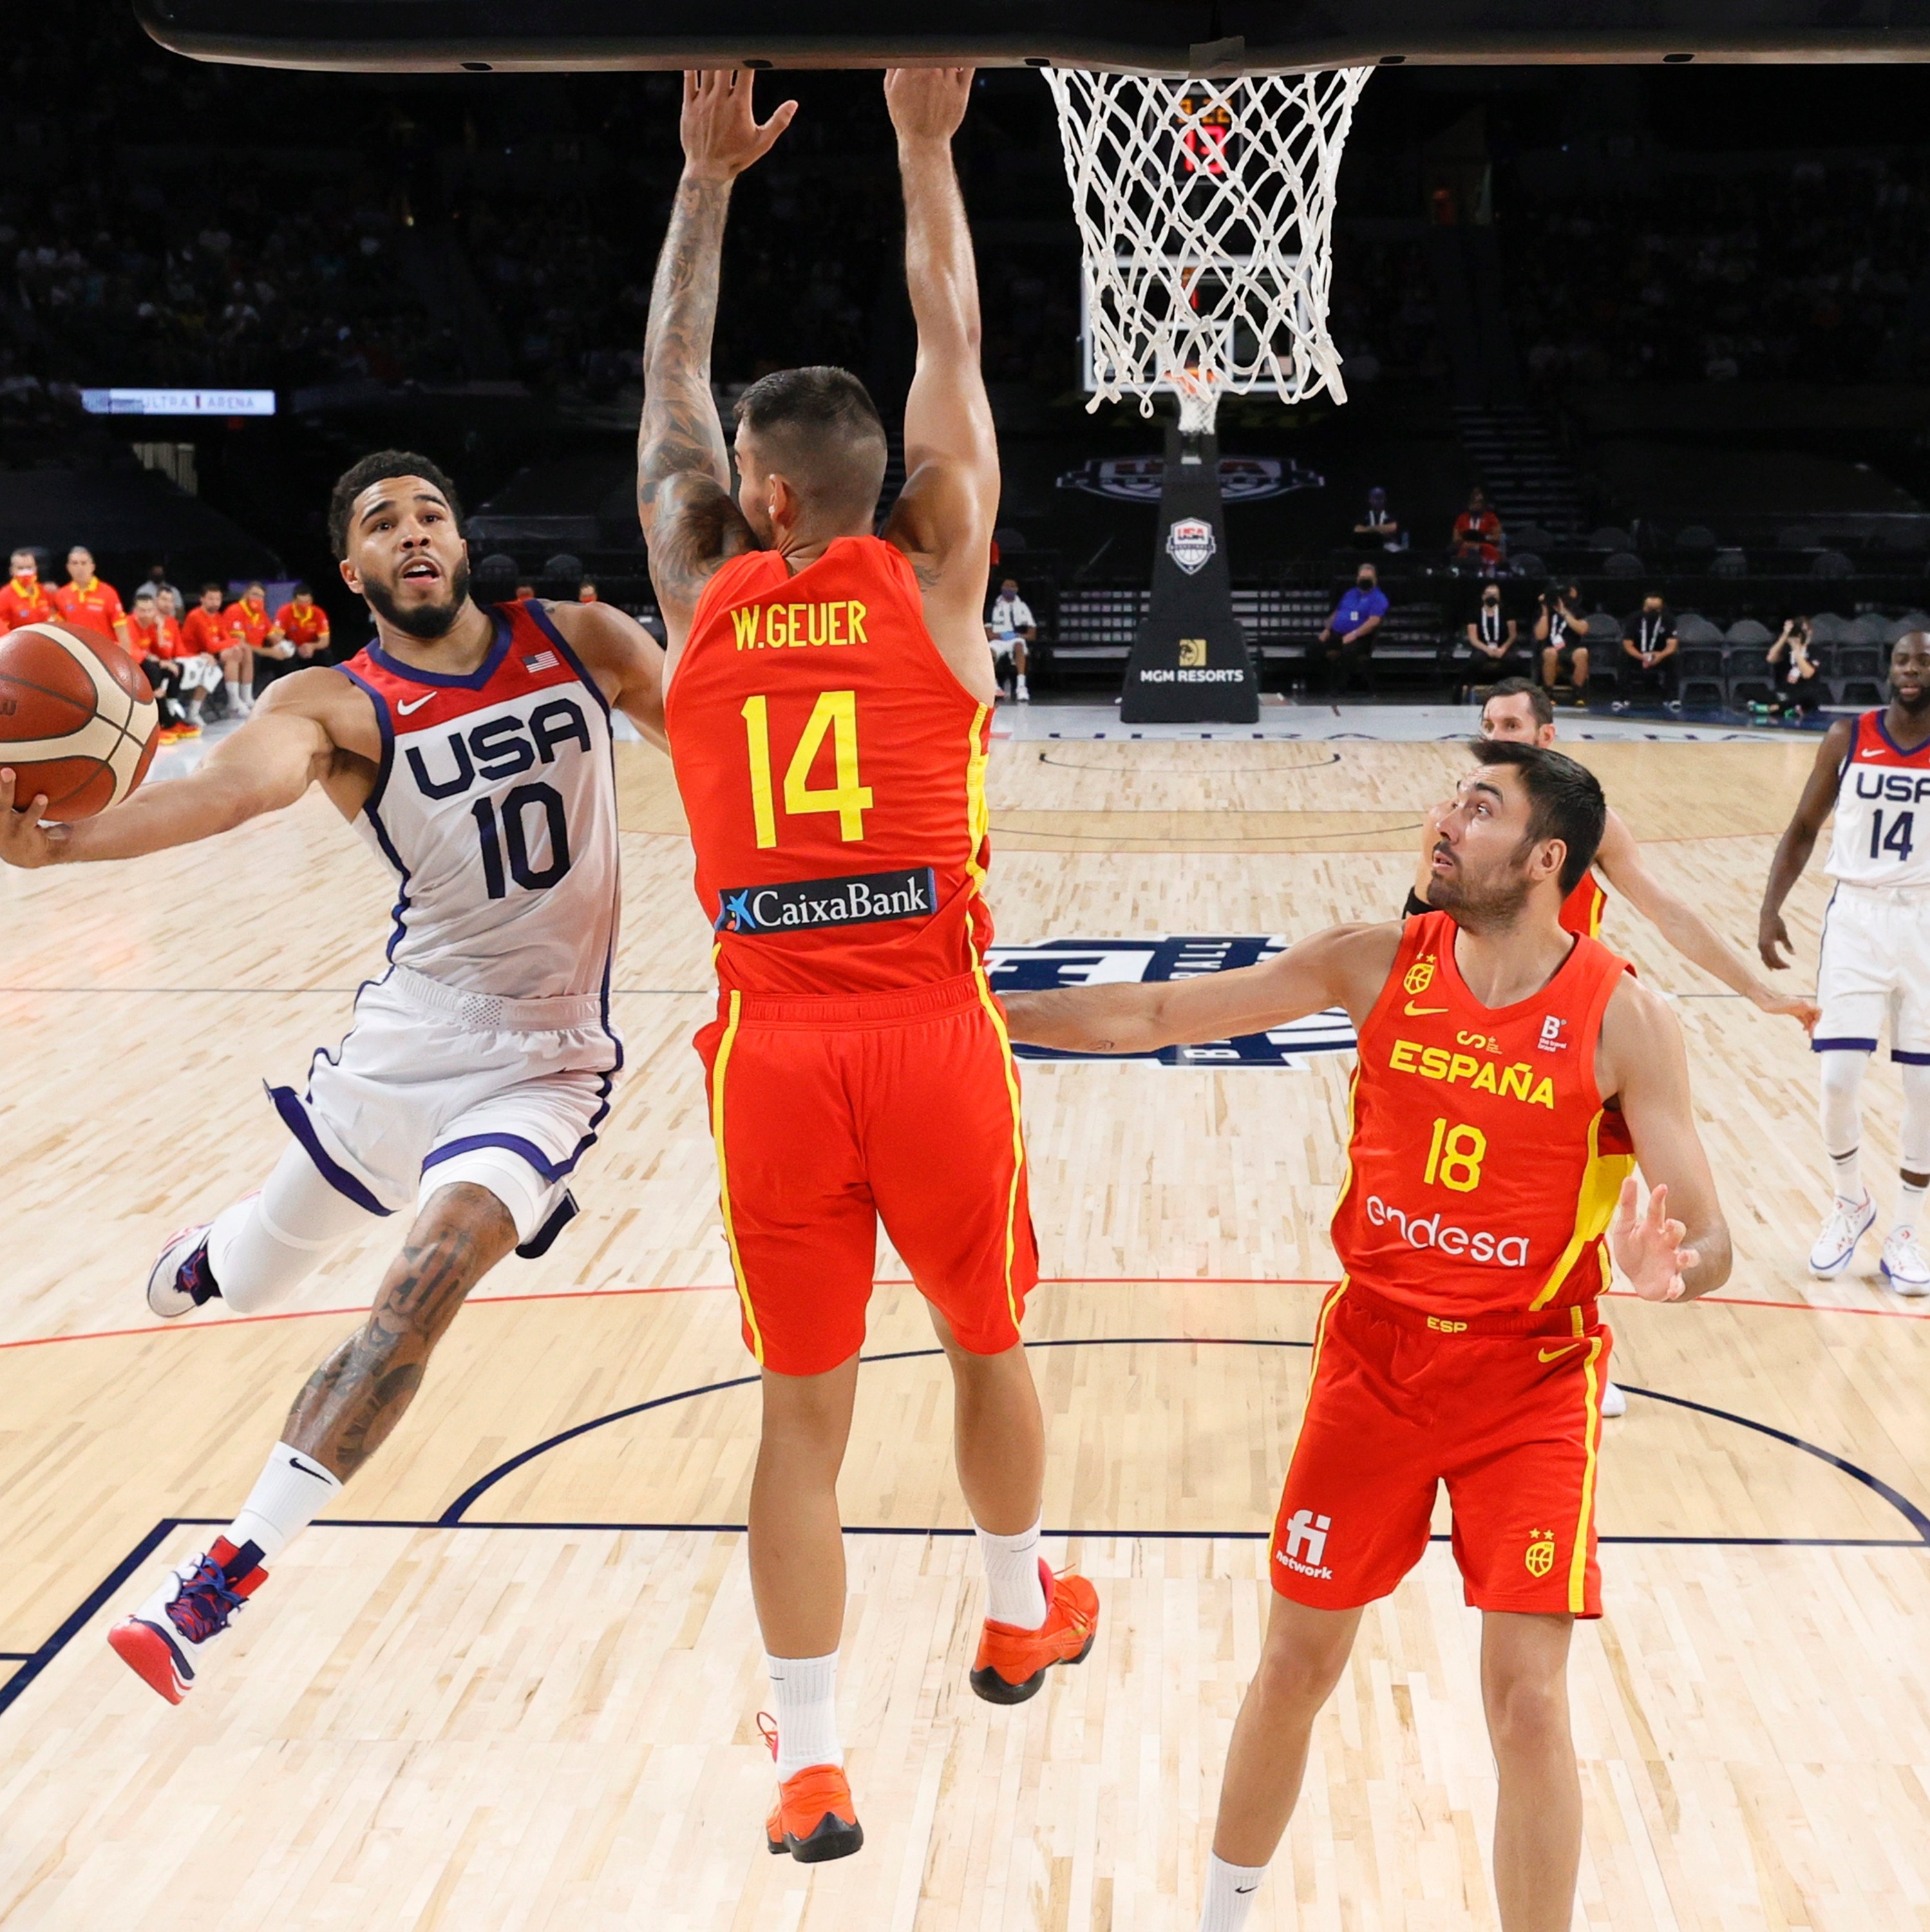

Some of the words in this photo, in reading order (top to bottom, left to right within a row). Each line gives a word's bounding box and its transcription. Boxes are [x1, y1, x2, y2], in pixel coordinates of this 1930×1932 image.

[730, 600, 868, 651] W.GEUER
[1140, 670, 1175, 682] MGM
[1177, 669, 1244, 682] RESORTS
[405, 698, 591, 800] USA
[740, 690, 873, 849] 14
[471, 782, 570, 899] 10
[1870, 808, 1914, 862] 14
[753, 876, 929, 927] CaixaBank
[1389, 1039, 1554, 1110] ESPAÑA
[1423, 1117, 1487, 1193] 18
[1366, 1195, 1531, 1267] endesa
[1427, 1316, 1468, 1333] ESP
[1276, 1549, 1333, 1580] network
